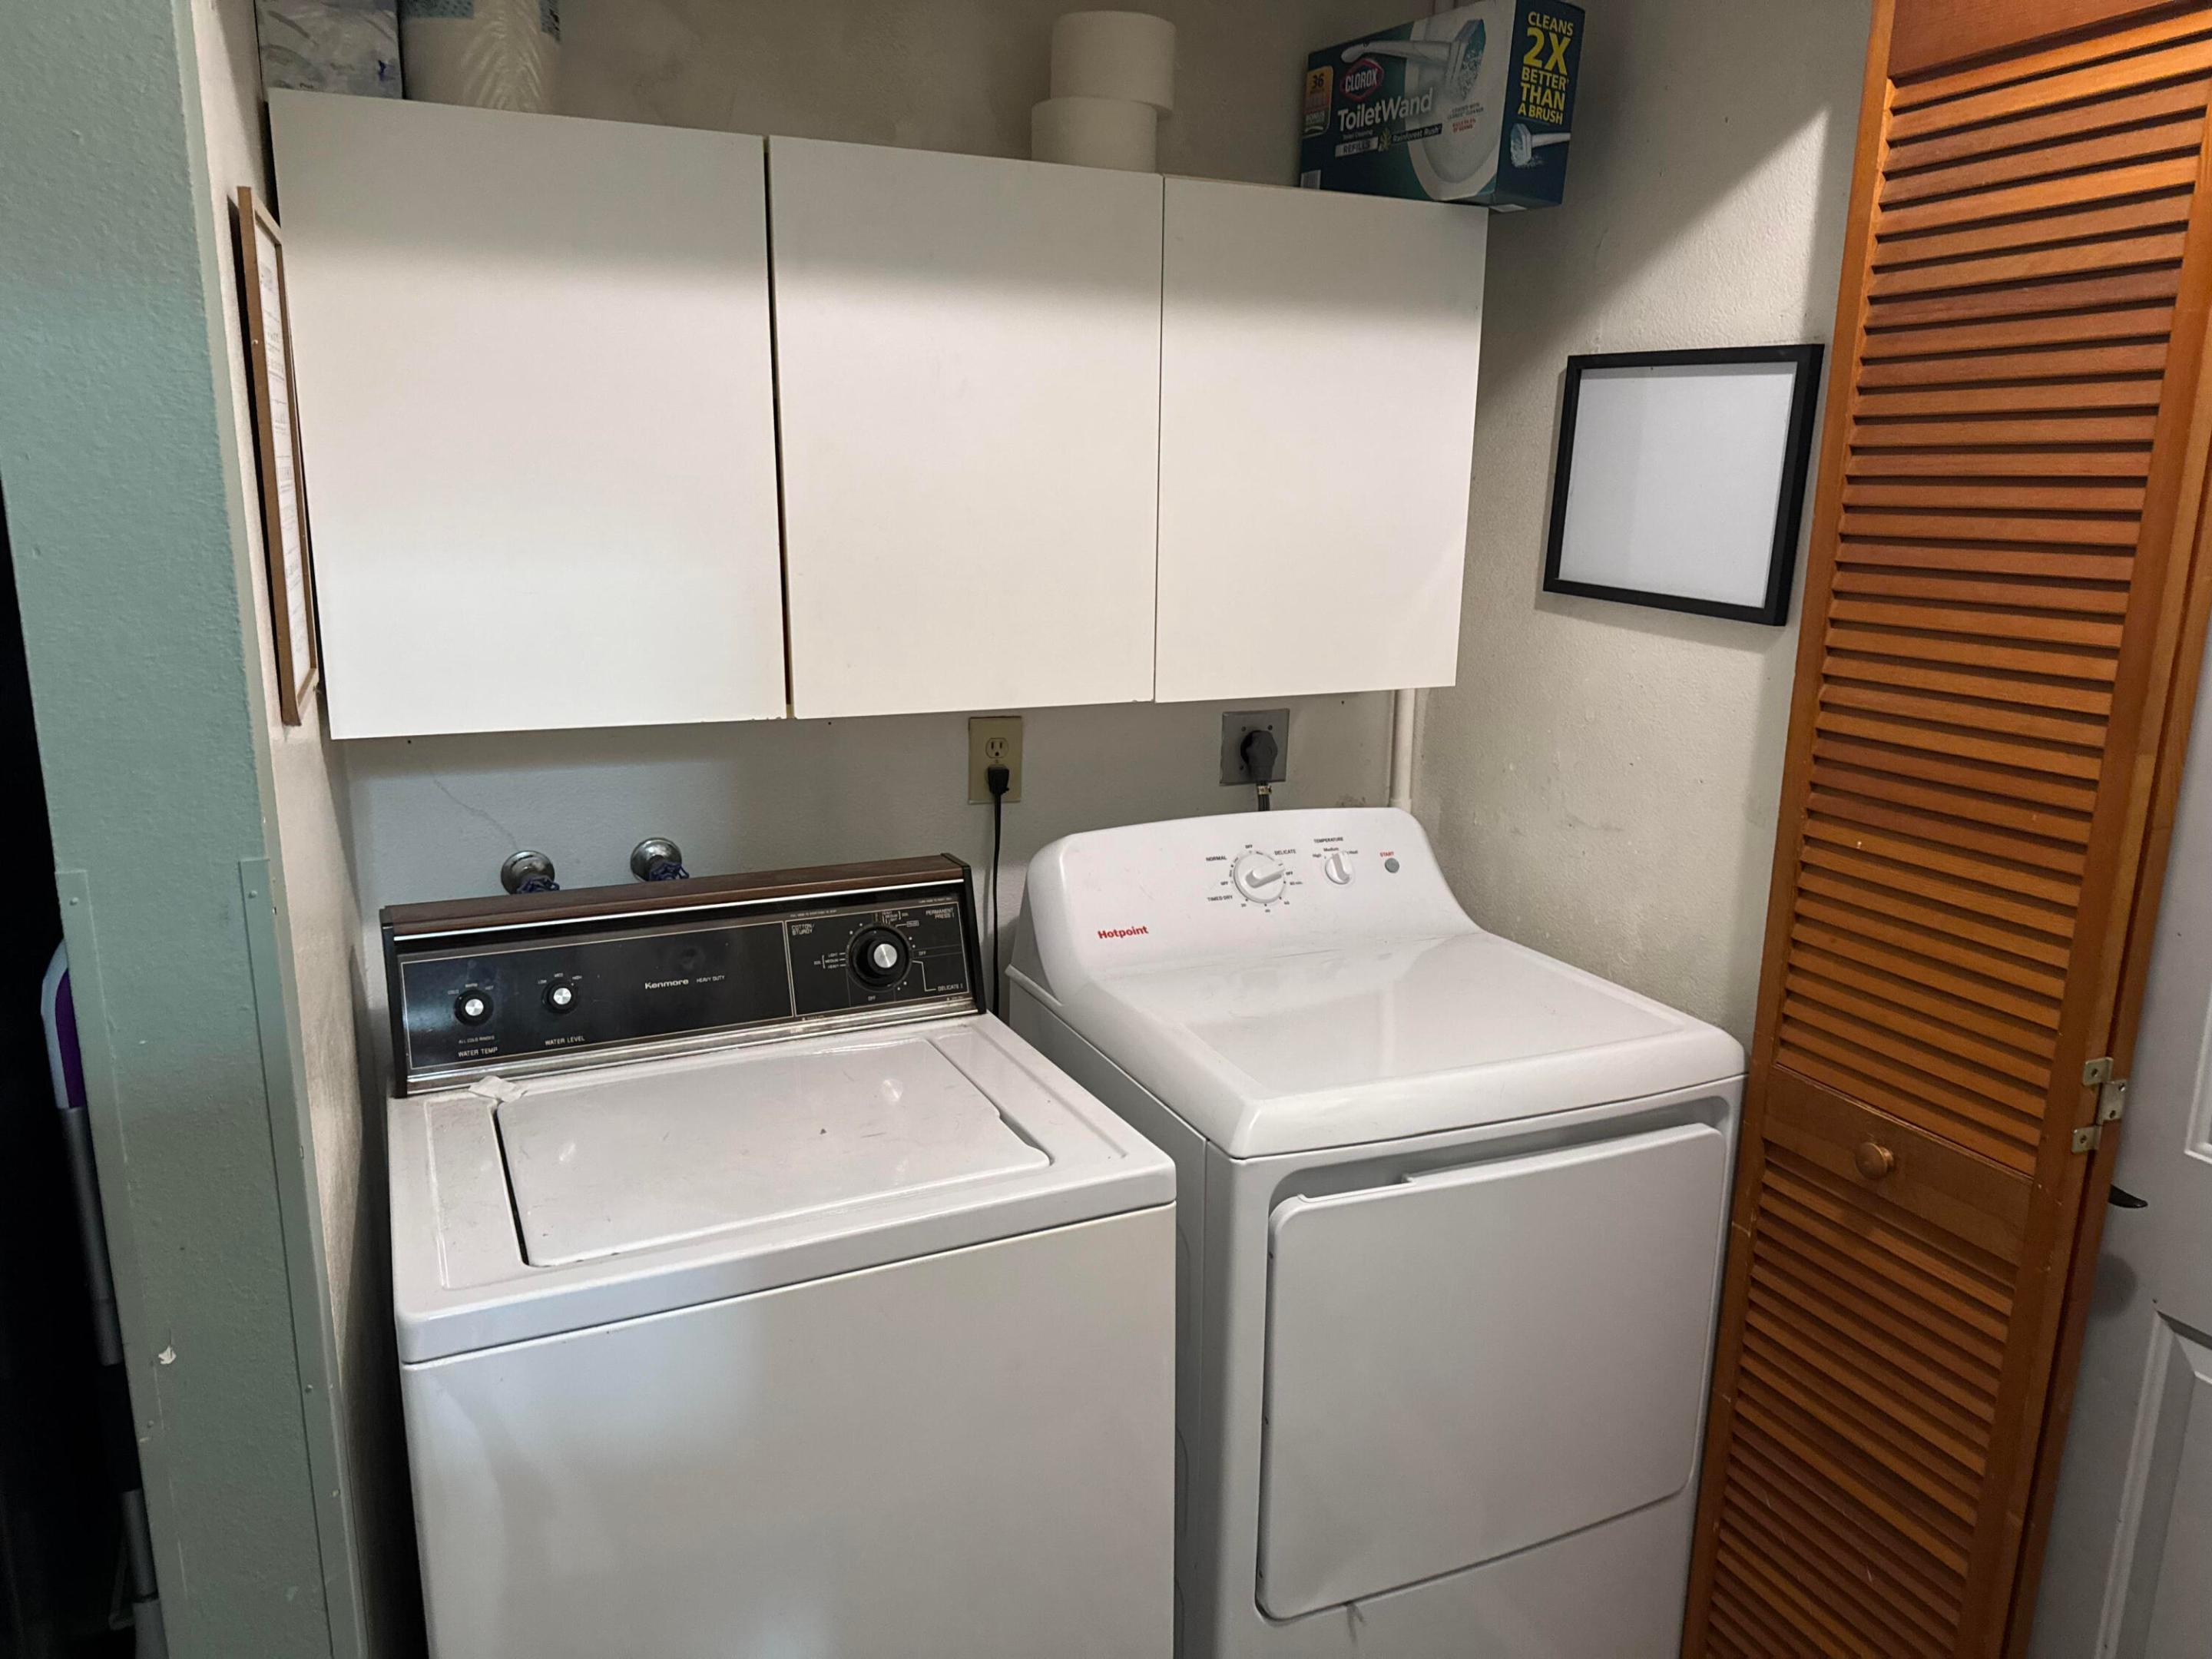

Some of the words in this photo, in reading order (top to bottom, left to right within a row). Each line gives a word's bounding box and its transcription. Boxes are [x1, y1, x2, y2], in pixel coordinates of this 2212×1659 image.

[1528, 12, 1574, 36] CLEANS
[1523, 27, 1571, 75] 2X
[1312, 73, 1325, 89] 36
[1345, 67, 1378, 94] CLOROX
[1520, 82, 1565, 111] THAN
[1338, 88, 1433, 131] ToiletWand
[1518, 103, 1526, 116] A
[1528, 105, 1564, 125] BRUSH
[1392, 128, 1423, 142] Rainforest
[1343, 141, 1370, 154] REFILLS
[926, 908, 954, 916] PERMANENT
[1098, 925, 1149, 939] Hotpoint
[644, 978, 689, 989] Kenmore
[458, 1049, 478, 1058] WATER
